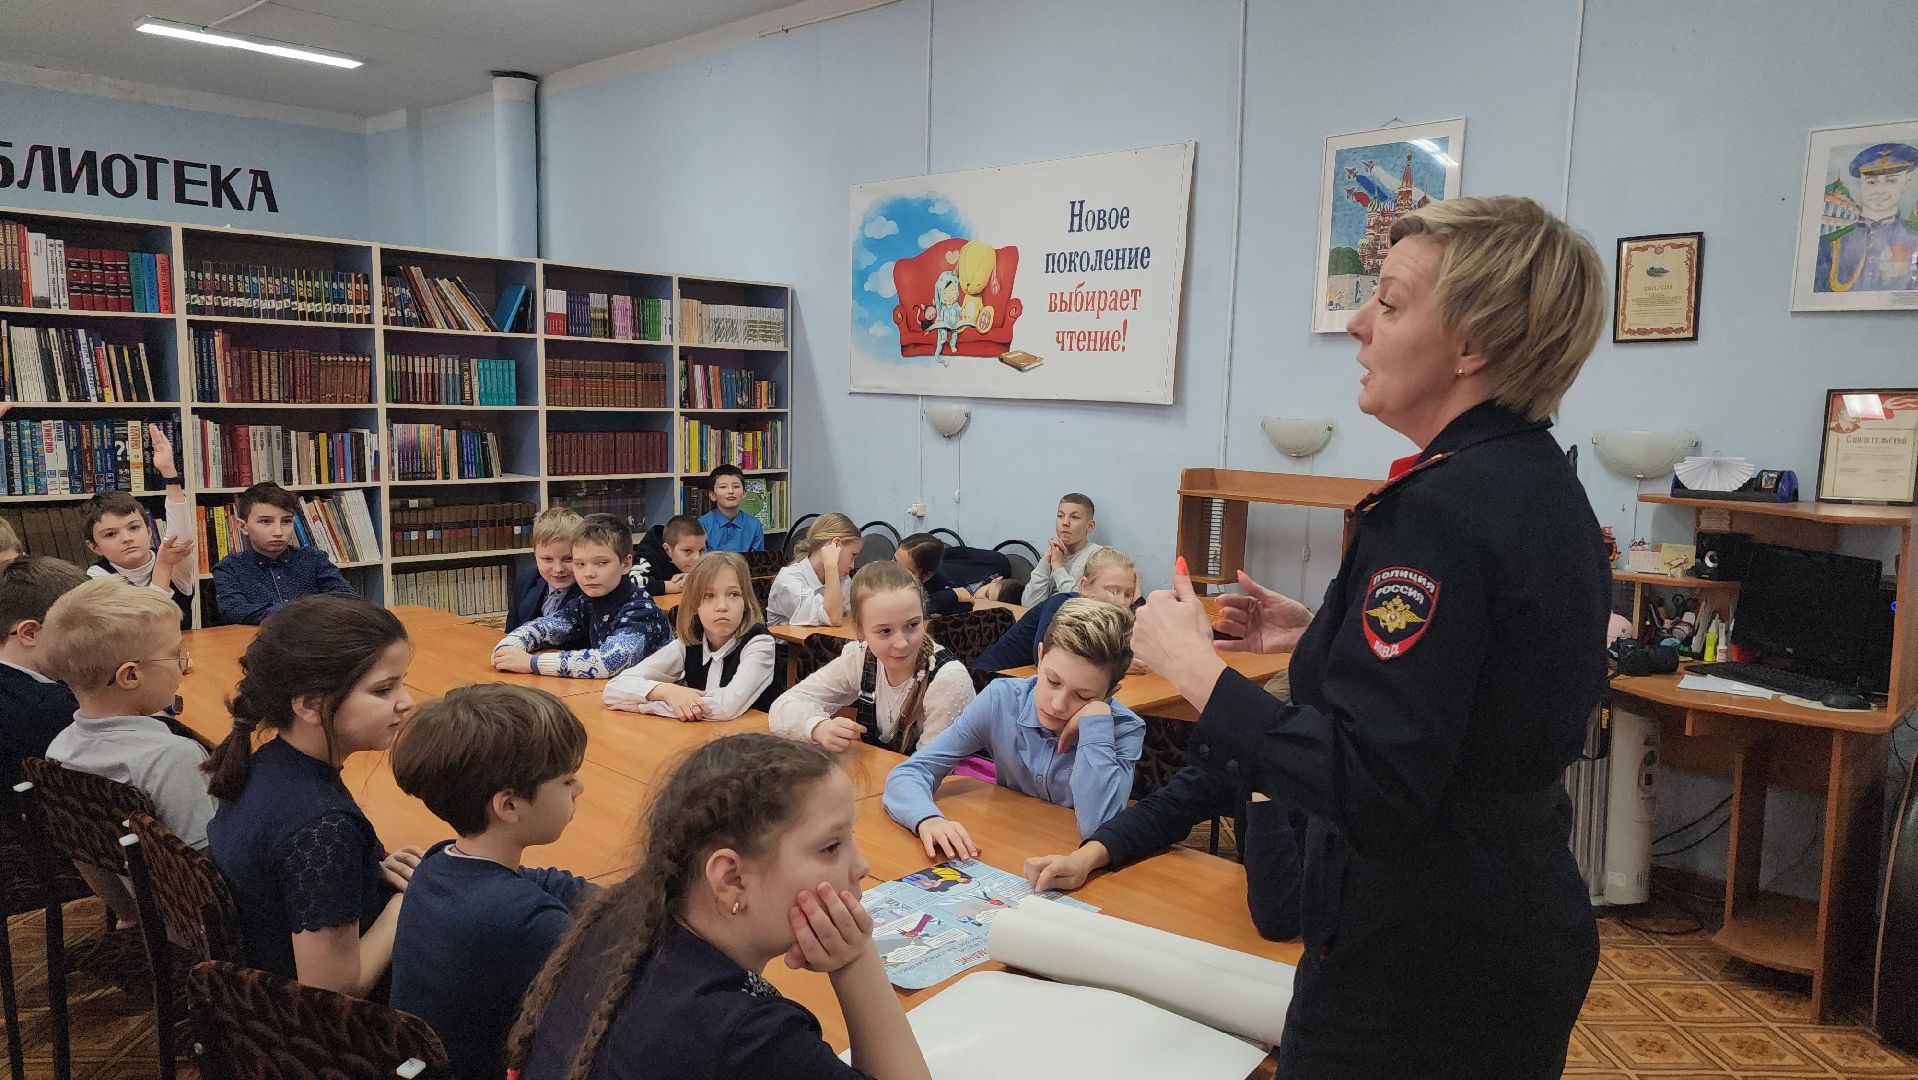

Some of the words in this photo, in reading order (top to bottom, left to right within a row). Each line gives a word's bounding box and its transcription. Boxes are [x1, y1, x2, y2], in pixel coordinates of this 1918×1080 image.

[1067, 200, 1130, 233] Новое
[1045, 246, 1151, 274] поколение
[1047, 281, 1142, 319] выбирает
[1055, 319, 1128, 353] чтение!
[43, 423, 54, 453] ФИЗИКА
[55, 422, 64, 442] ХИМИЯ
[1372, 569, 1436, 594] ПОЛИЦИЯ
[1375, 584, 1425, 605] РОССИЯ
[1373, 639, 1400, 658] МВД
